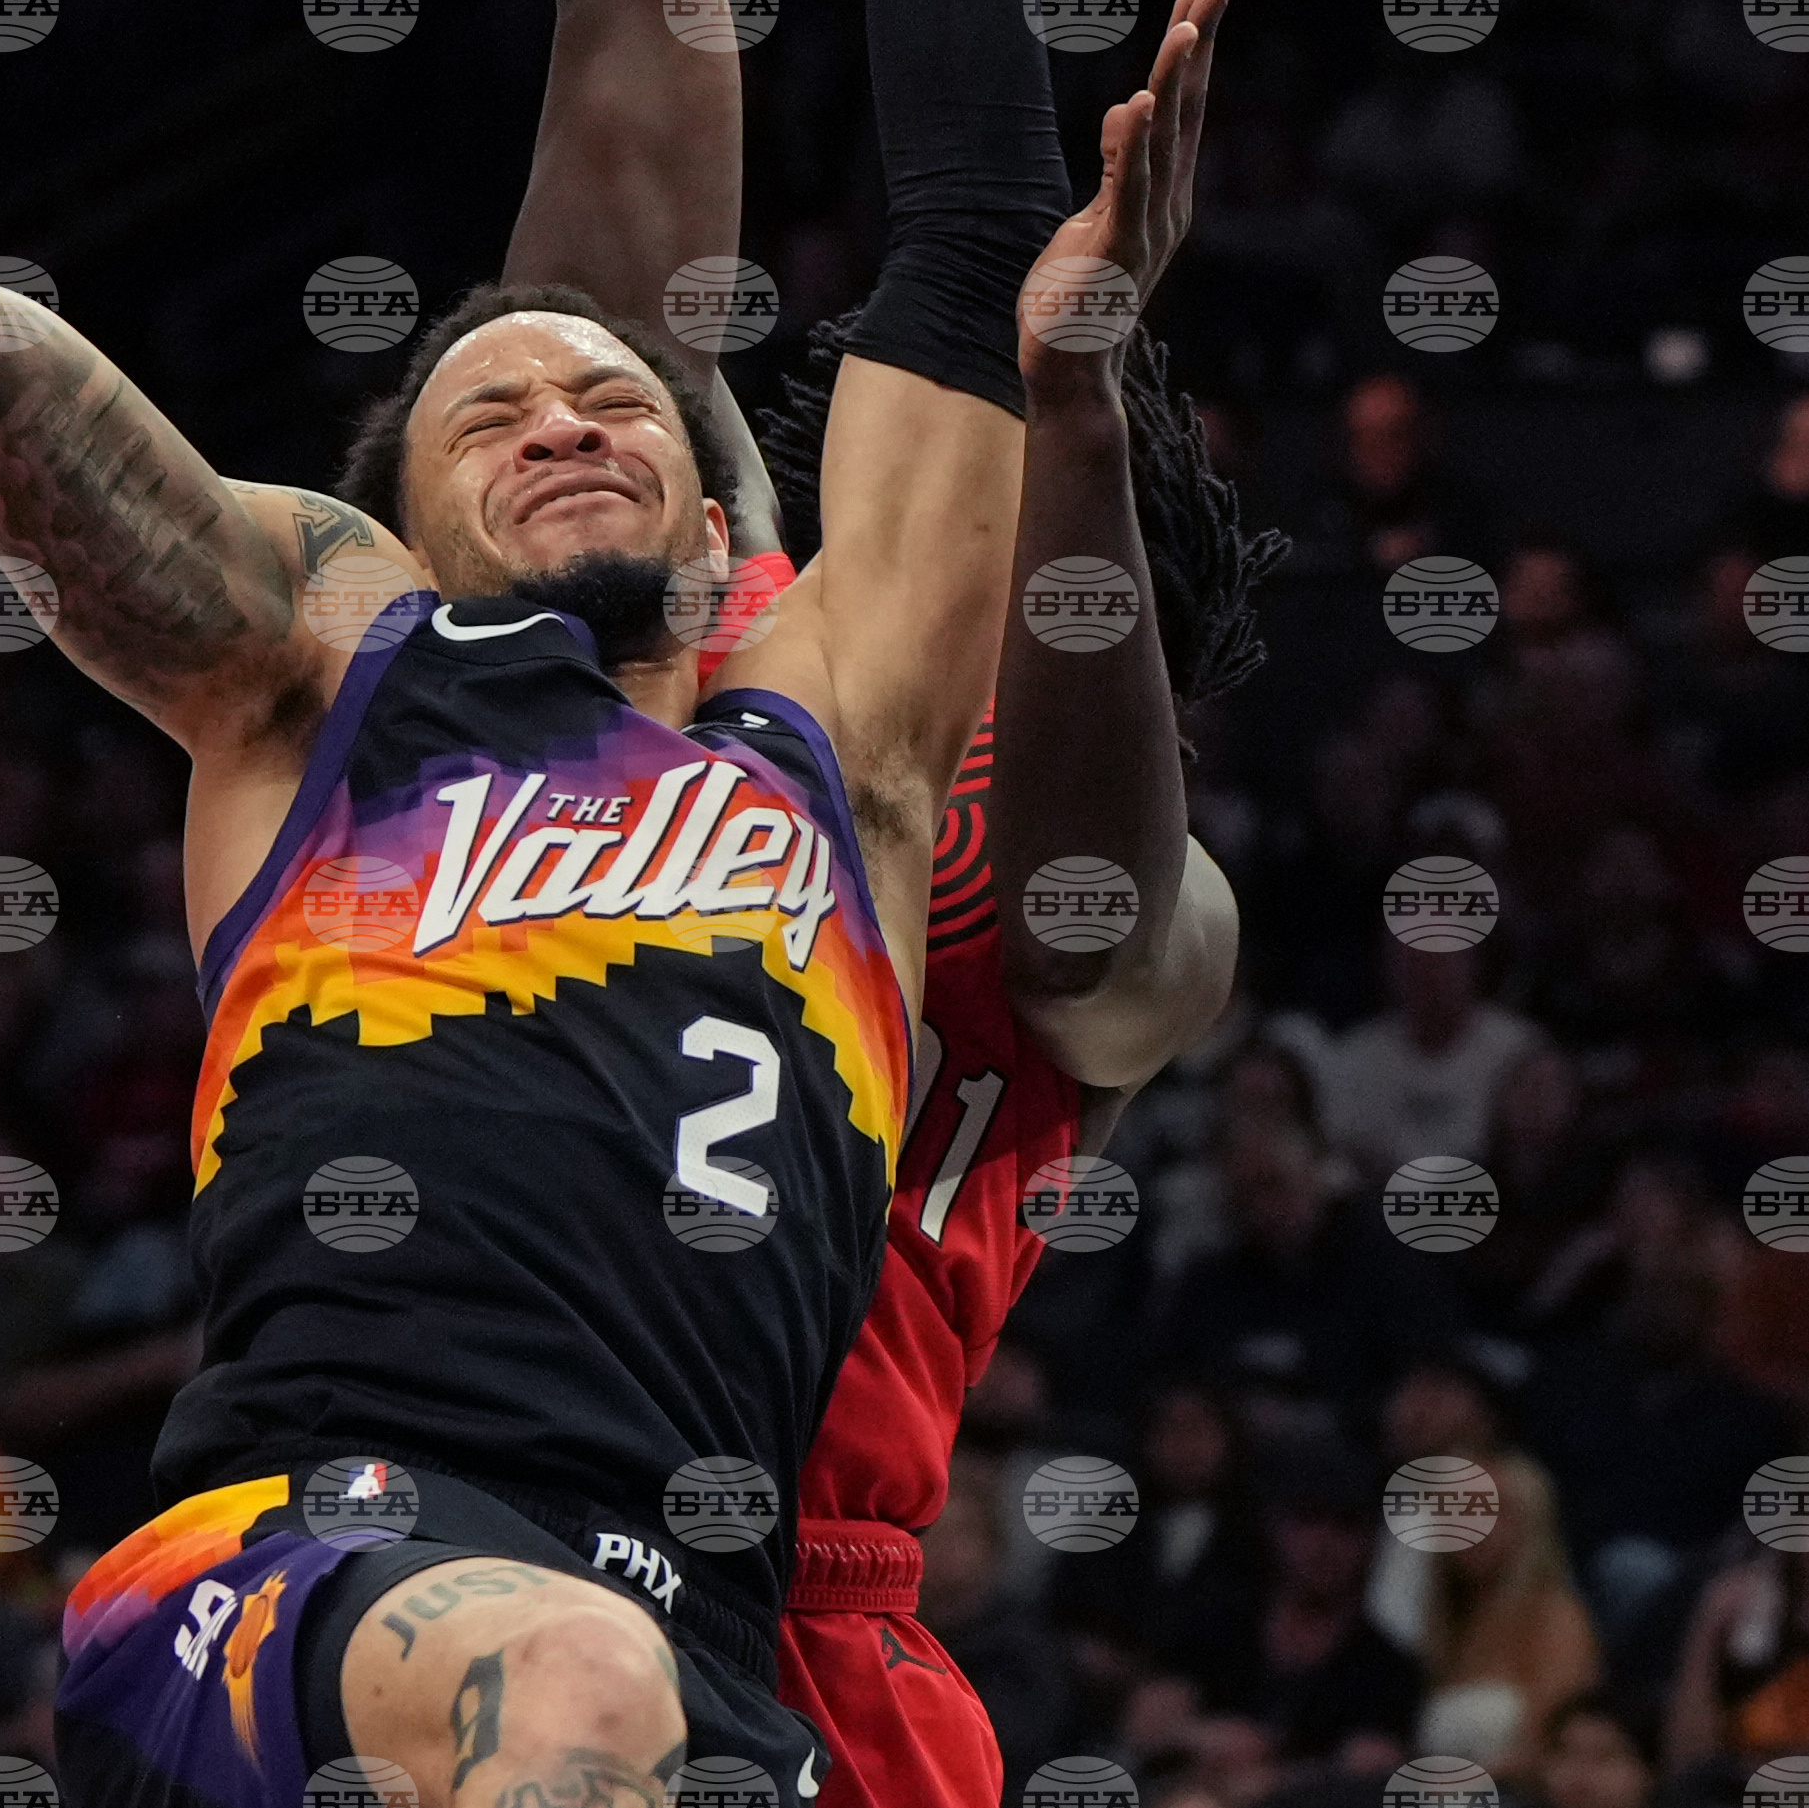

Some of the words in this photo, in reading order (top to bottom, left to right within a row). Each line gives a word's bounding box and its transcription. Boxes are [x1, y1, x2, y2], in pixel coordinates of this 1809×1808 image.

[413, 759, 836, 972] Valley
[547, 792, 633, 825] THE
[677, 1015, 781, 1218] 2
[592, 1532, 682, 1614] PHX
